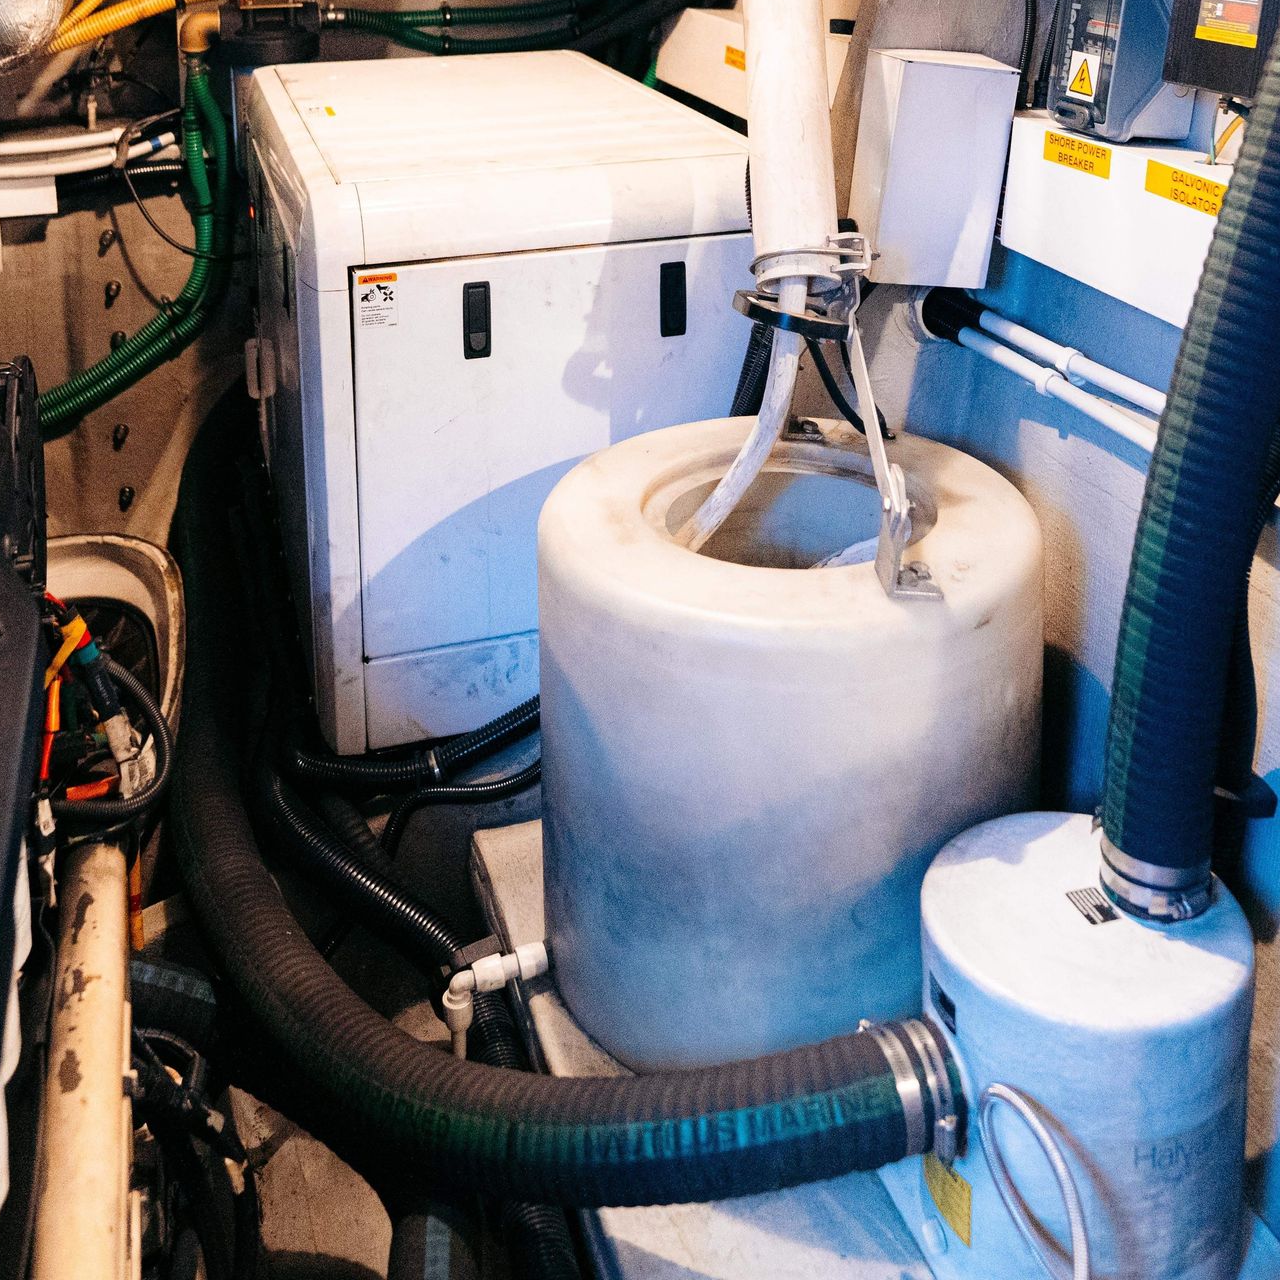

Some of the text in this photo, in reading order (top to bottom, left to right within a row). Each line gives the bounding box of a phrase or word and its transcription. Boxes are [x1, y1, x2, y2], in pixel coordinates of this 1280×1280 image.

[1049, 133, 1107, 160] SHORE POWER
[1057, 152, 1095, 172] BREAKER
[1171, 170, 1220, 197] GALVONIC
[1169, 186, 1218, 215] ISOLATOR
